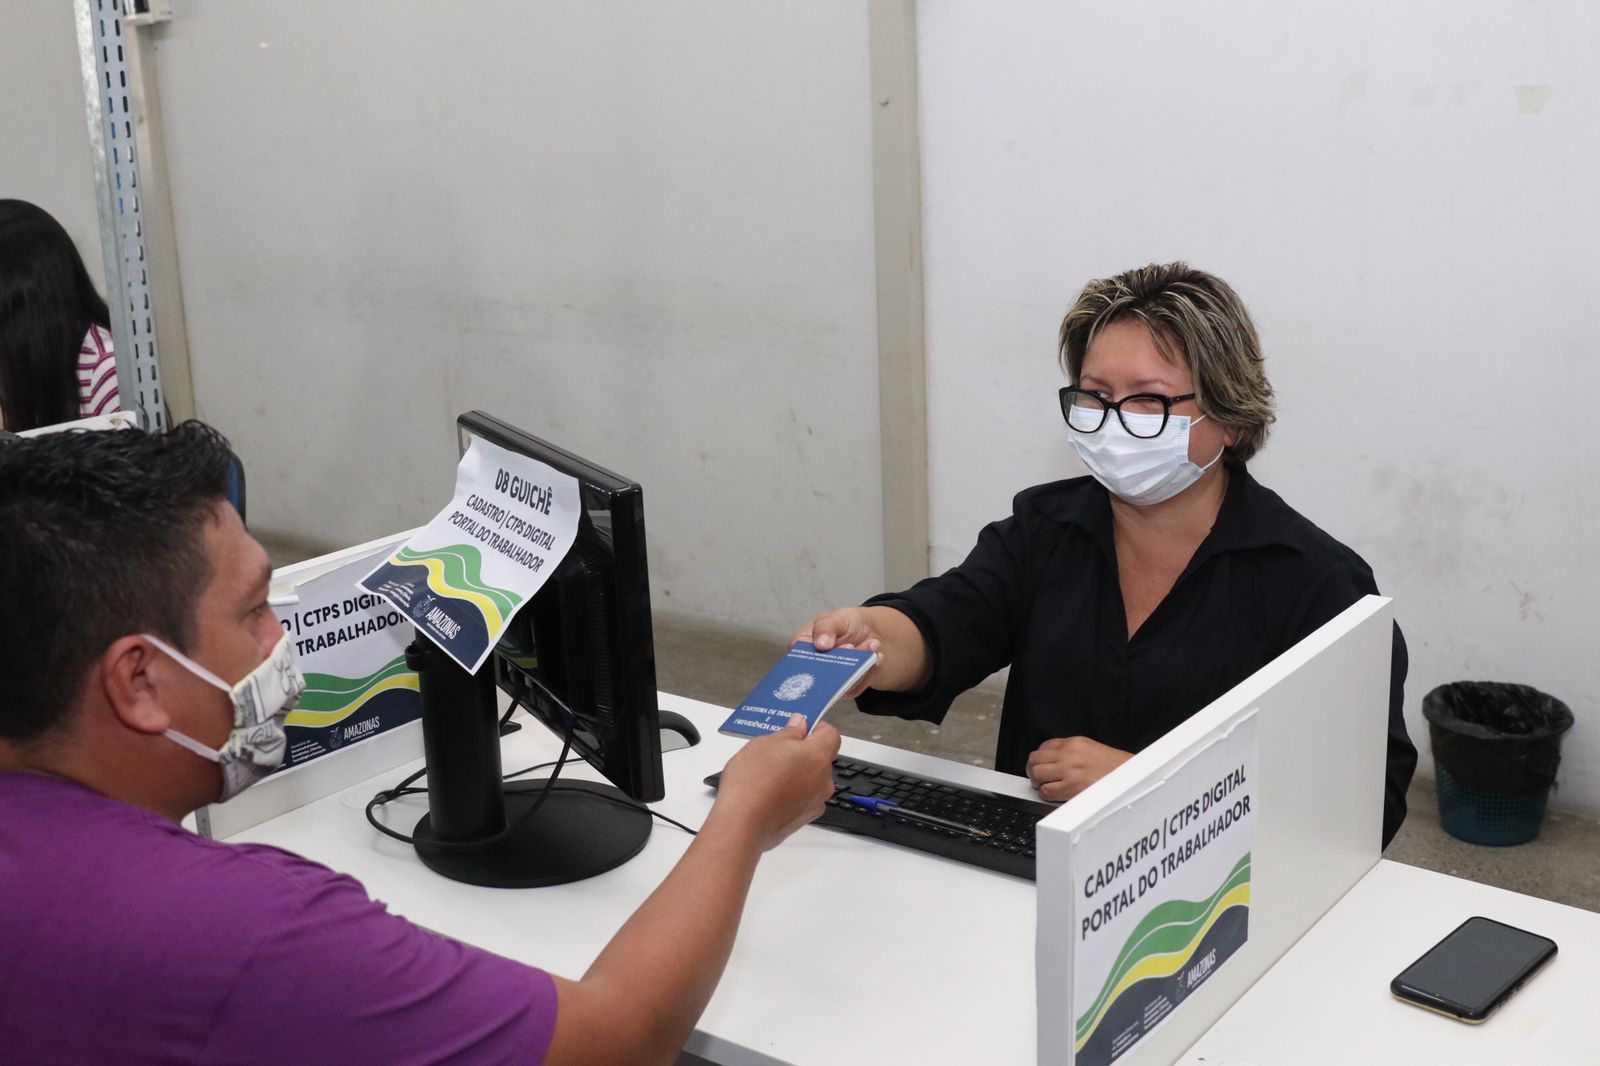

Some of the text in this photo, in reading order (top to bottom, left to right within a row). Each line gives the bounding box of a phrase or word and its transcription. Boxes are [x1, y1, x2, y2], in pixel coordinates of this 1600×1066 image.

[495, 468, 553, 516] 08 GUICHÊ
[448, 511, 545, 573] PORTAL DO TRABALHADOR
[466, 494, 505, 523] CADASTRO
[505, 515, 526, 535] CTPS
[523, 524, 556, 551] DIGITAL
[303, 603, 341, 627] CTPS
[343, 594, 387, 615] DIGI
[425, 606, 461, 640] AMAZONAS
[343, 716, 380, 740] AMAZONAS
[1084, 828, 1160, 898] CADASTRO
[1169, 799, 1200, 836] CTPS
[1202, 764, 1246, 813] DIGITAL
[1082, 795, 1251, 941] PORTAL DO TRABALHADOR
[1187, 948, 1216, 988] AMAZONAS
